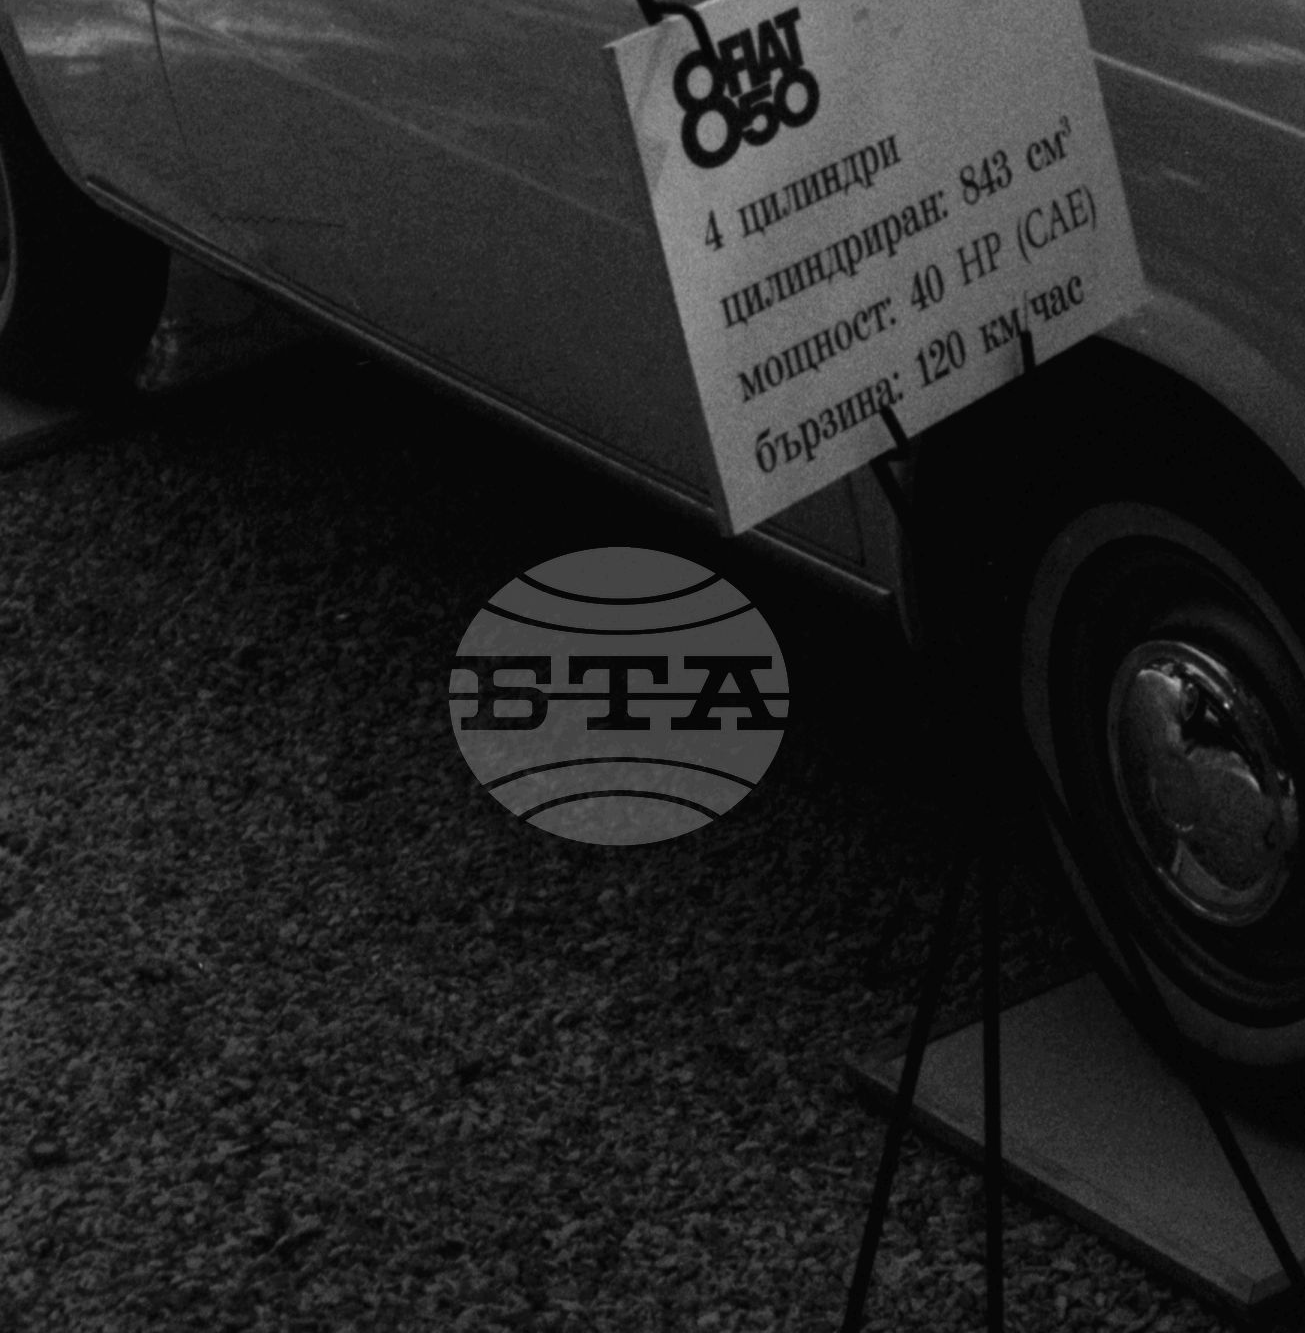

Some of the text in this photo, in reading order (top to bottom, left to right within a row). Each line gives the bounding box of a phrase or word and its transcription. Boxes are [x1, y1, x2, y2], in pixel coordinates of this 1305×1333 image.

[673, 49, 820, 169] 850
[717, 6, 804, 98] FIAT
[703, 134, 901, 251] 4 цилиндри
[718, 186, 949, 328] цилиндриран:
[960, 149, 1013, 206] 843
[736, 292, 897, 403] мощност:
[909, 264, 945, 313] 40
[754, 272, 1084, 473] бързина: 120 км/час
